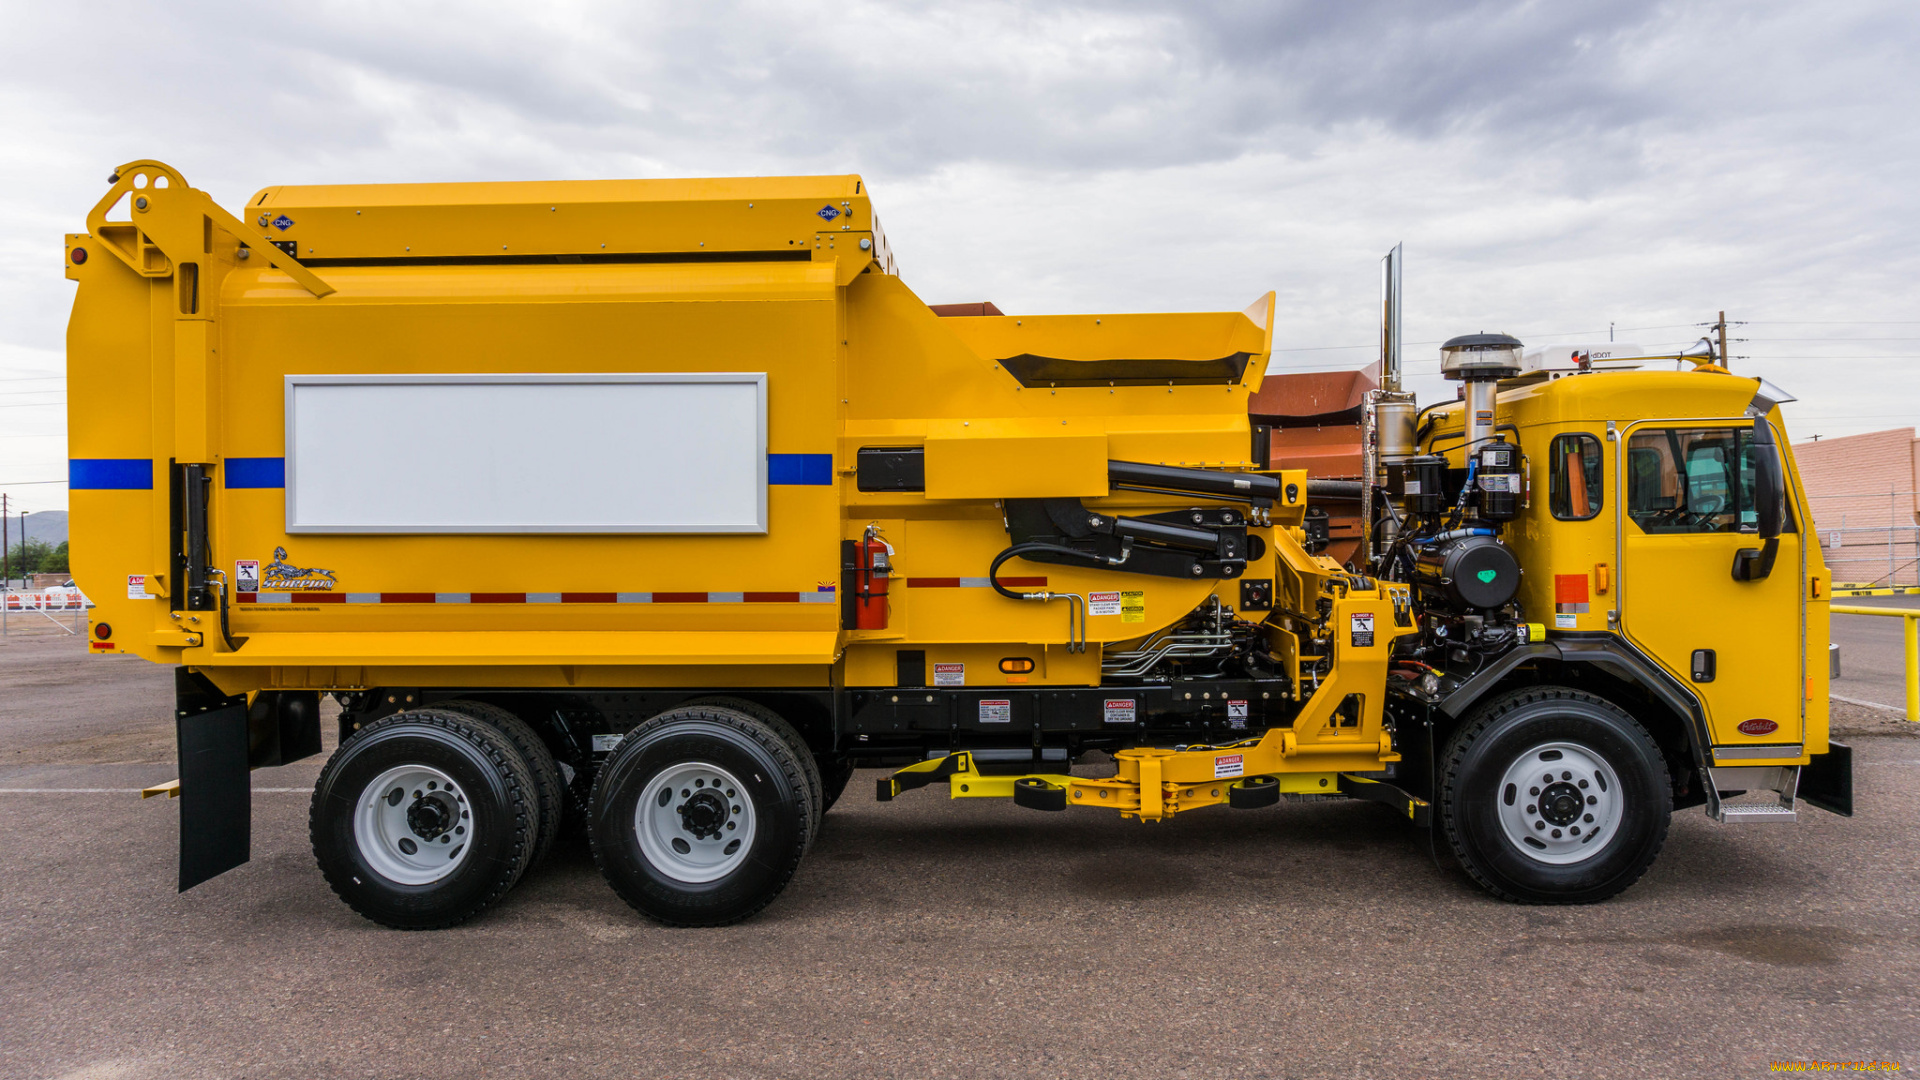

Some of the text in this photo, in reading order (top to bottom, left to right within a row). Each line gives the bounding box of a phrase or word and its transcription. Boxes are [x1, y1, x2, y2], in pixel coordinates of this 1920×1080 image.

[820, 209, 837, 217] CNG
[261, 579, 336, 588] SCORPION
[1742, 721, 1775, 731] Peterbilt
[1222, 756, 1240, 764] DANGER
